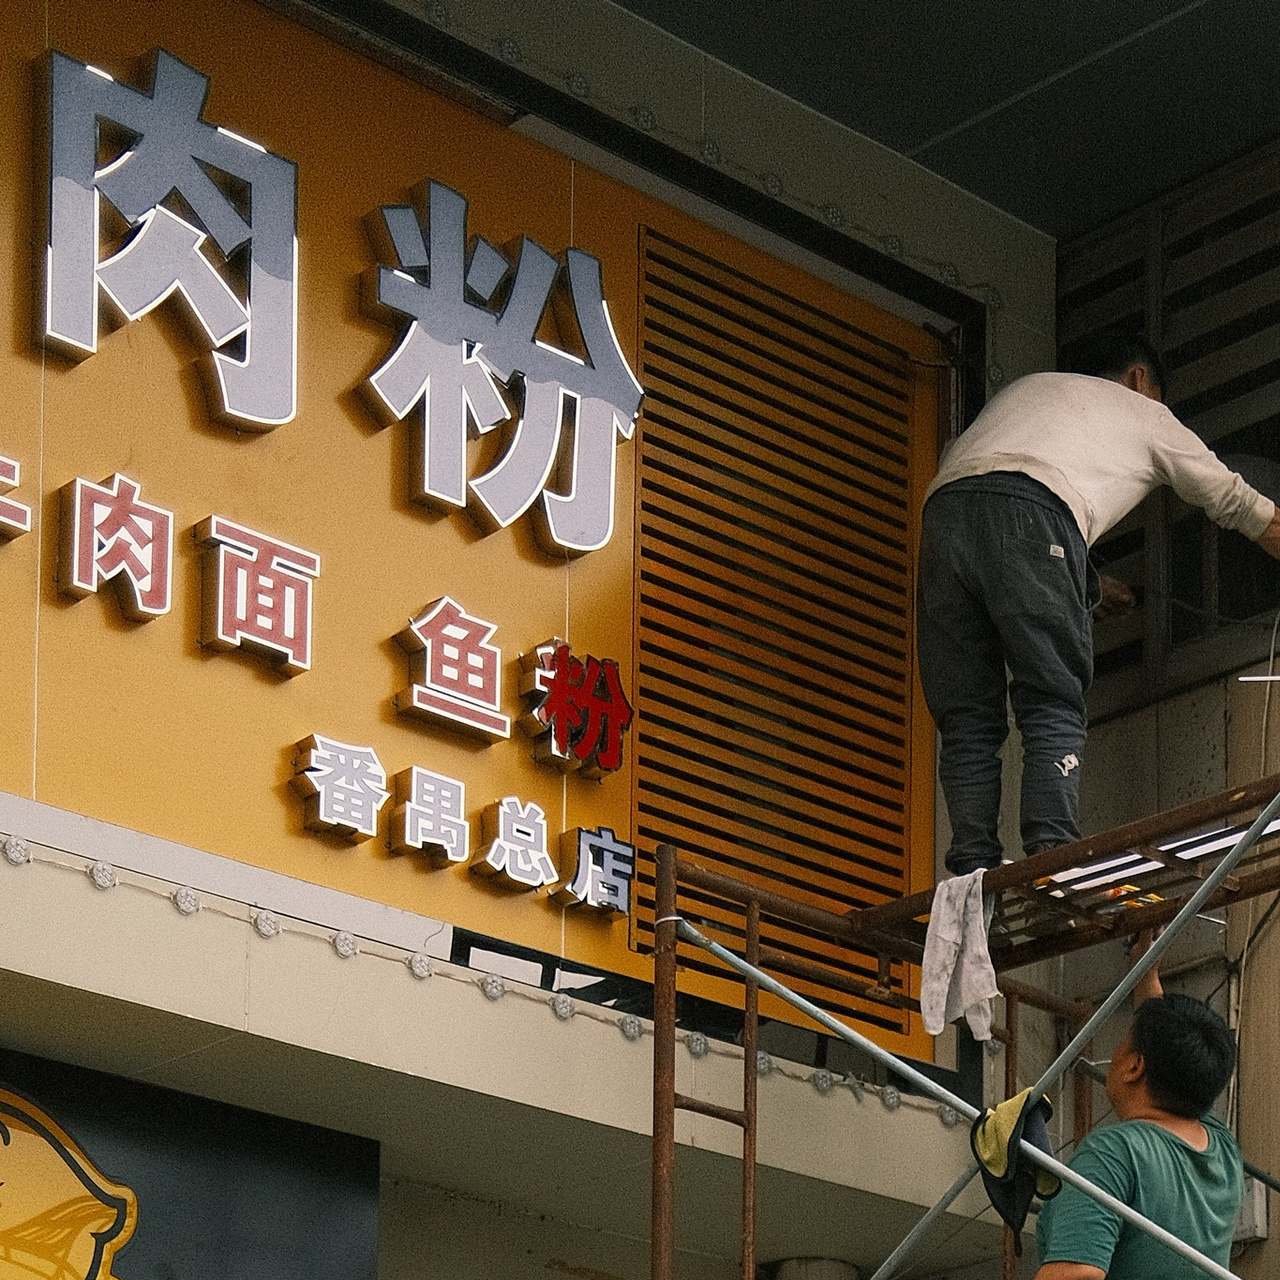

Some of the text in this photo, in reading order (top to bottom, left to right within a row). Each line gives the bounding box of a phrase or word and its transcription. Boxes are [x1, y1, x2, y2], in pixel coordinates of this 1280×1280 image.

[46, 48, 646, 552] 肉粉
[408, 596, 634, 772] 鱼粉
[306, 735, 636, 916] 番禺总店
